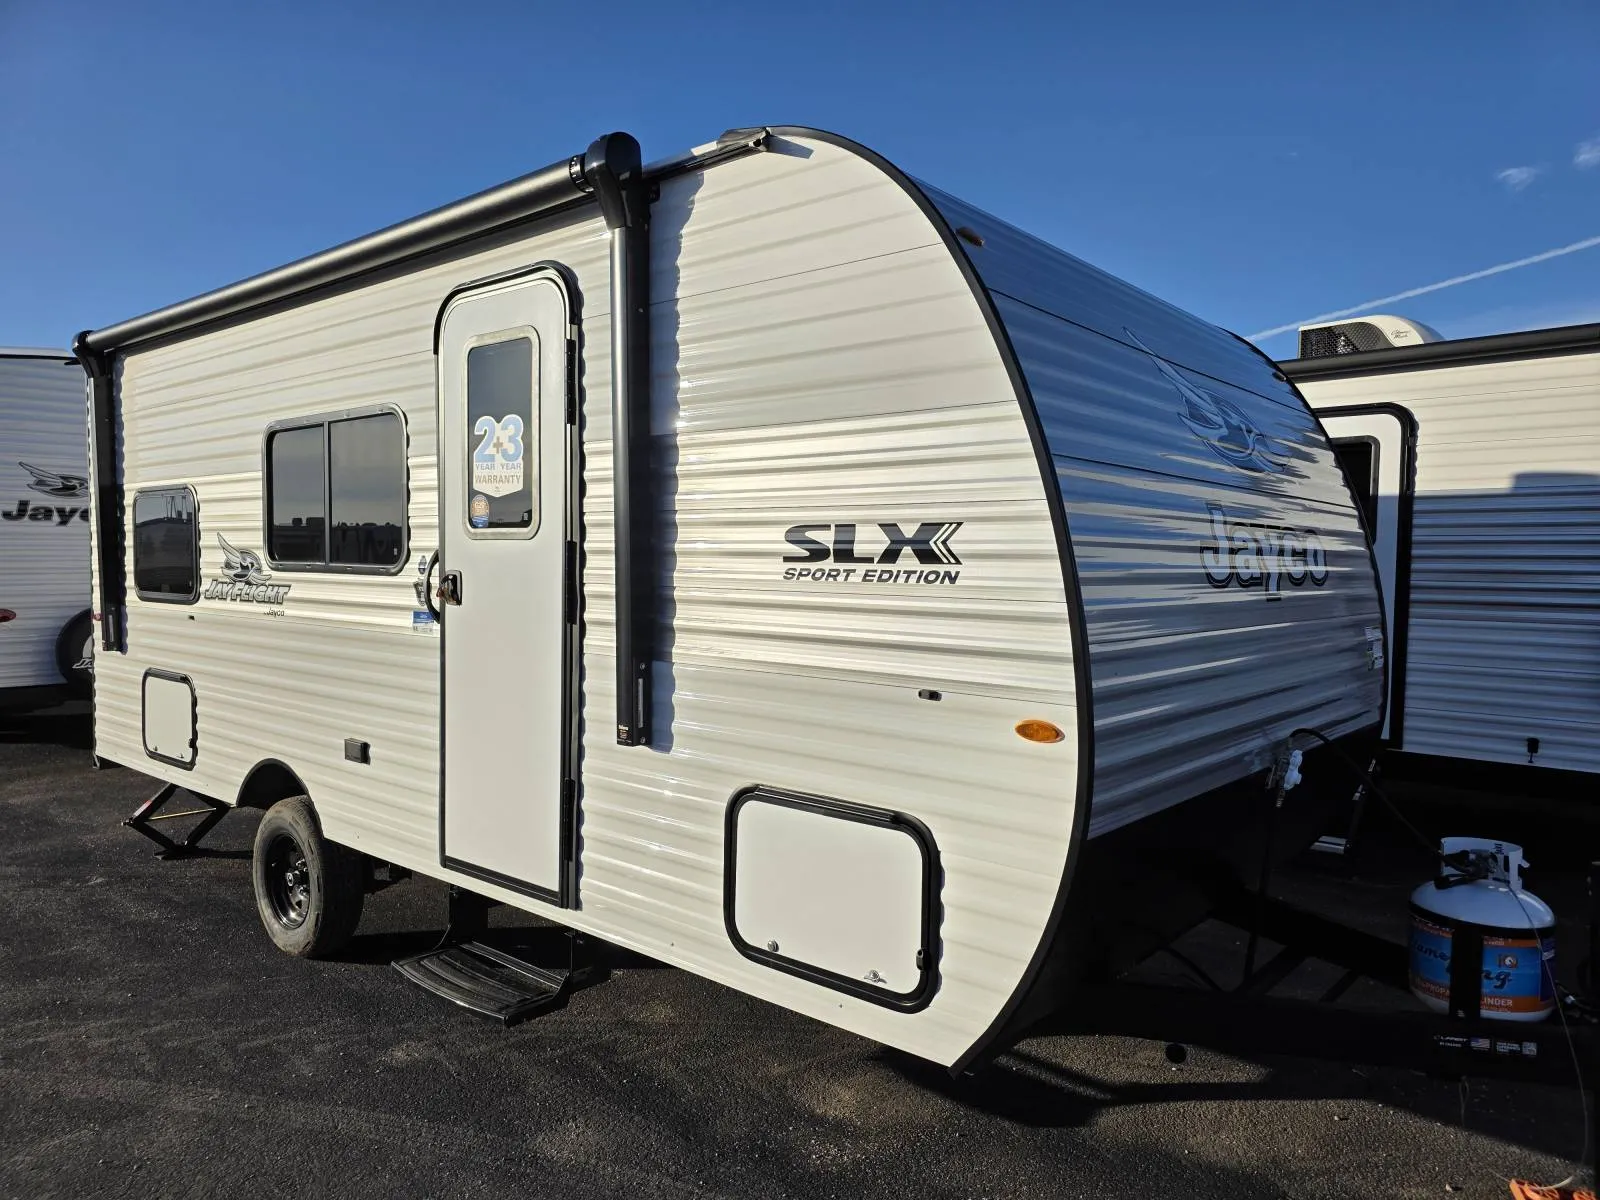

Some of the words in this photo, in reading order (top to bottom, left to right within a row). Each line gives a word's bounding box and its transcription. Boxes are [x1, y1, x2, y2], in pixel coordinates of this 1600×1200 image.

[474, 474, 521, 485] WARRANTY
[783, 522, 964, 565] SLX
[1200, 502, 1329, 602] Jayco
[783, 567, 856, 582] SPORT
[861, 569, 960, 585] EDITION
